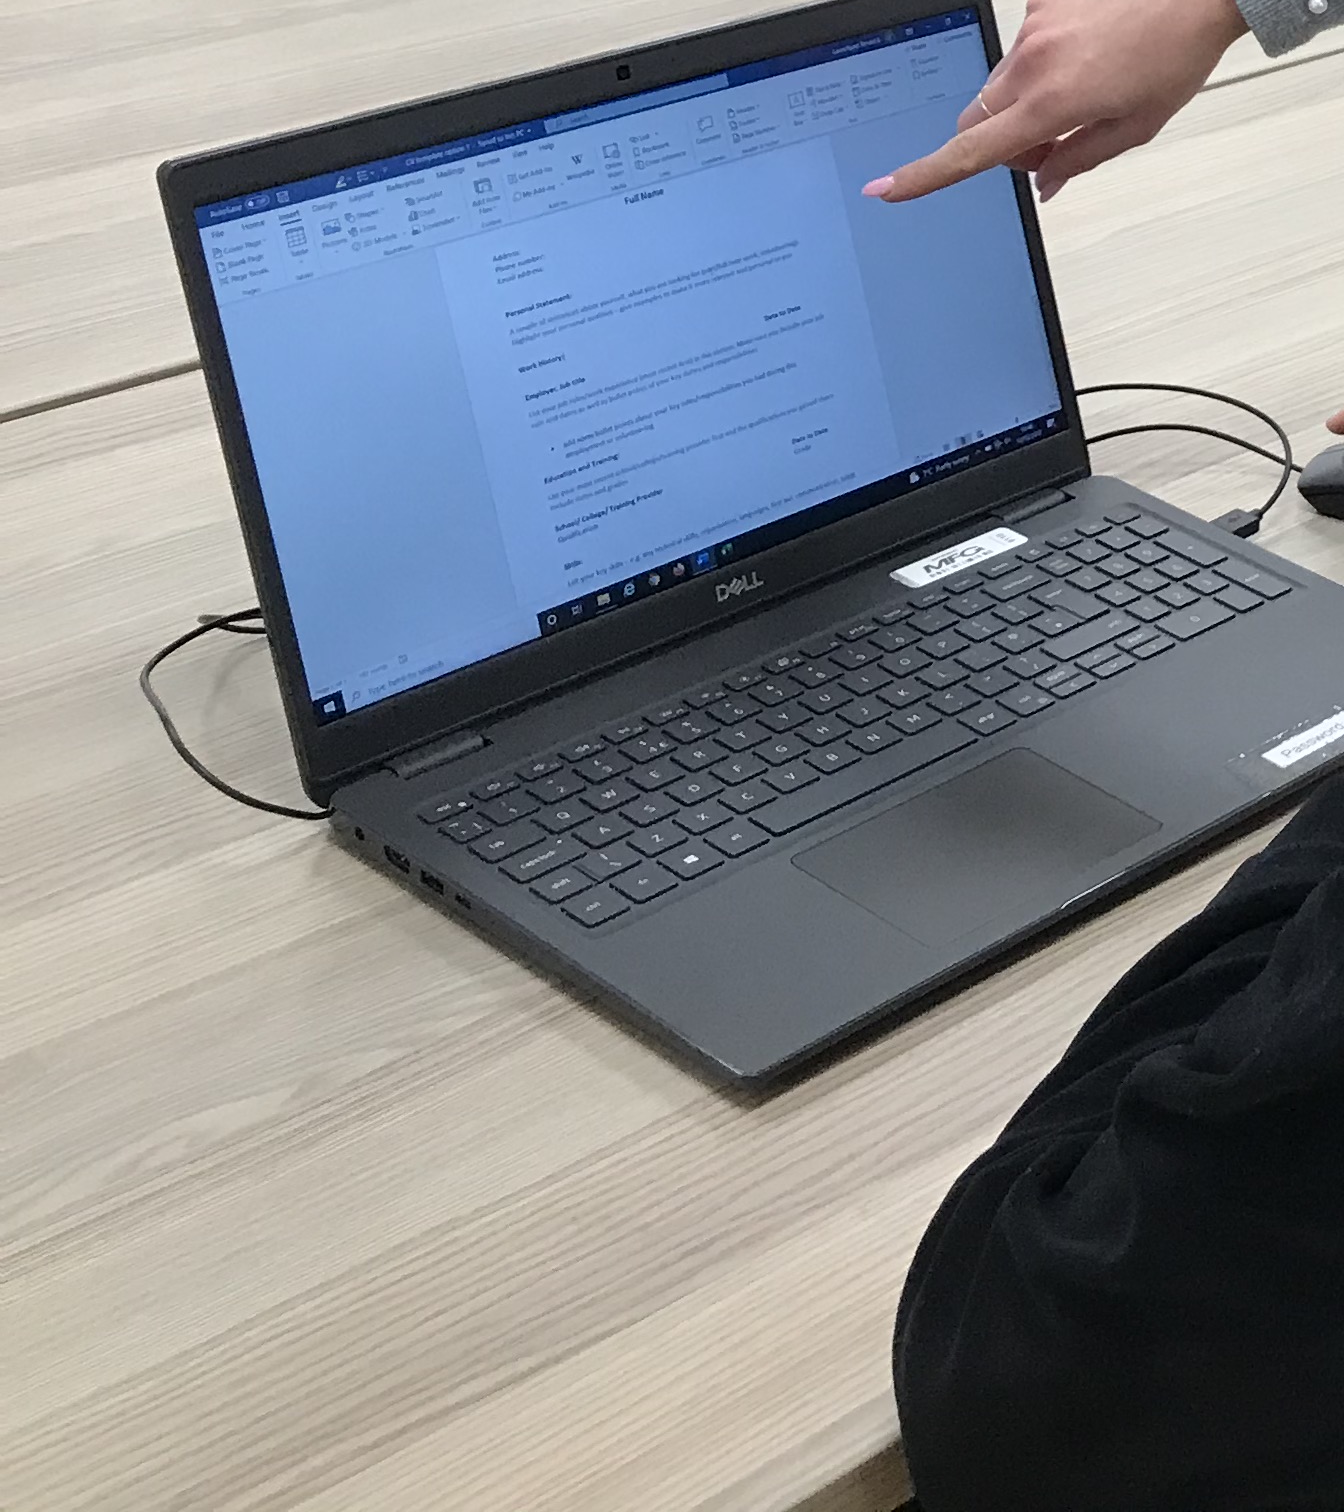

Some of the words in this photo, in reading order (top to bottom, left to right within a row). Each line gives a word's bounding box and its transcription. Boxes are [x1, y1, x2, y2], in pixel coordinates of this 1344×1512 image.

[623, 190, 640, 206] Full
[639, 186, 666, 203] Name
[714, 571, 765, 603] DELL
